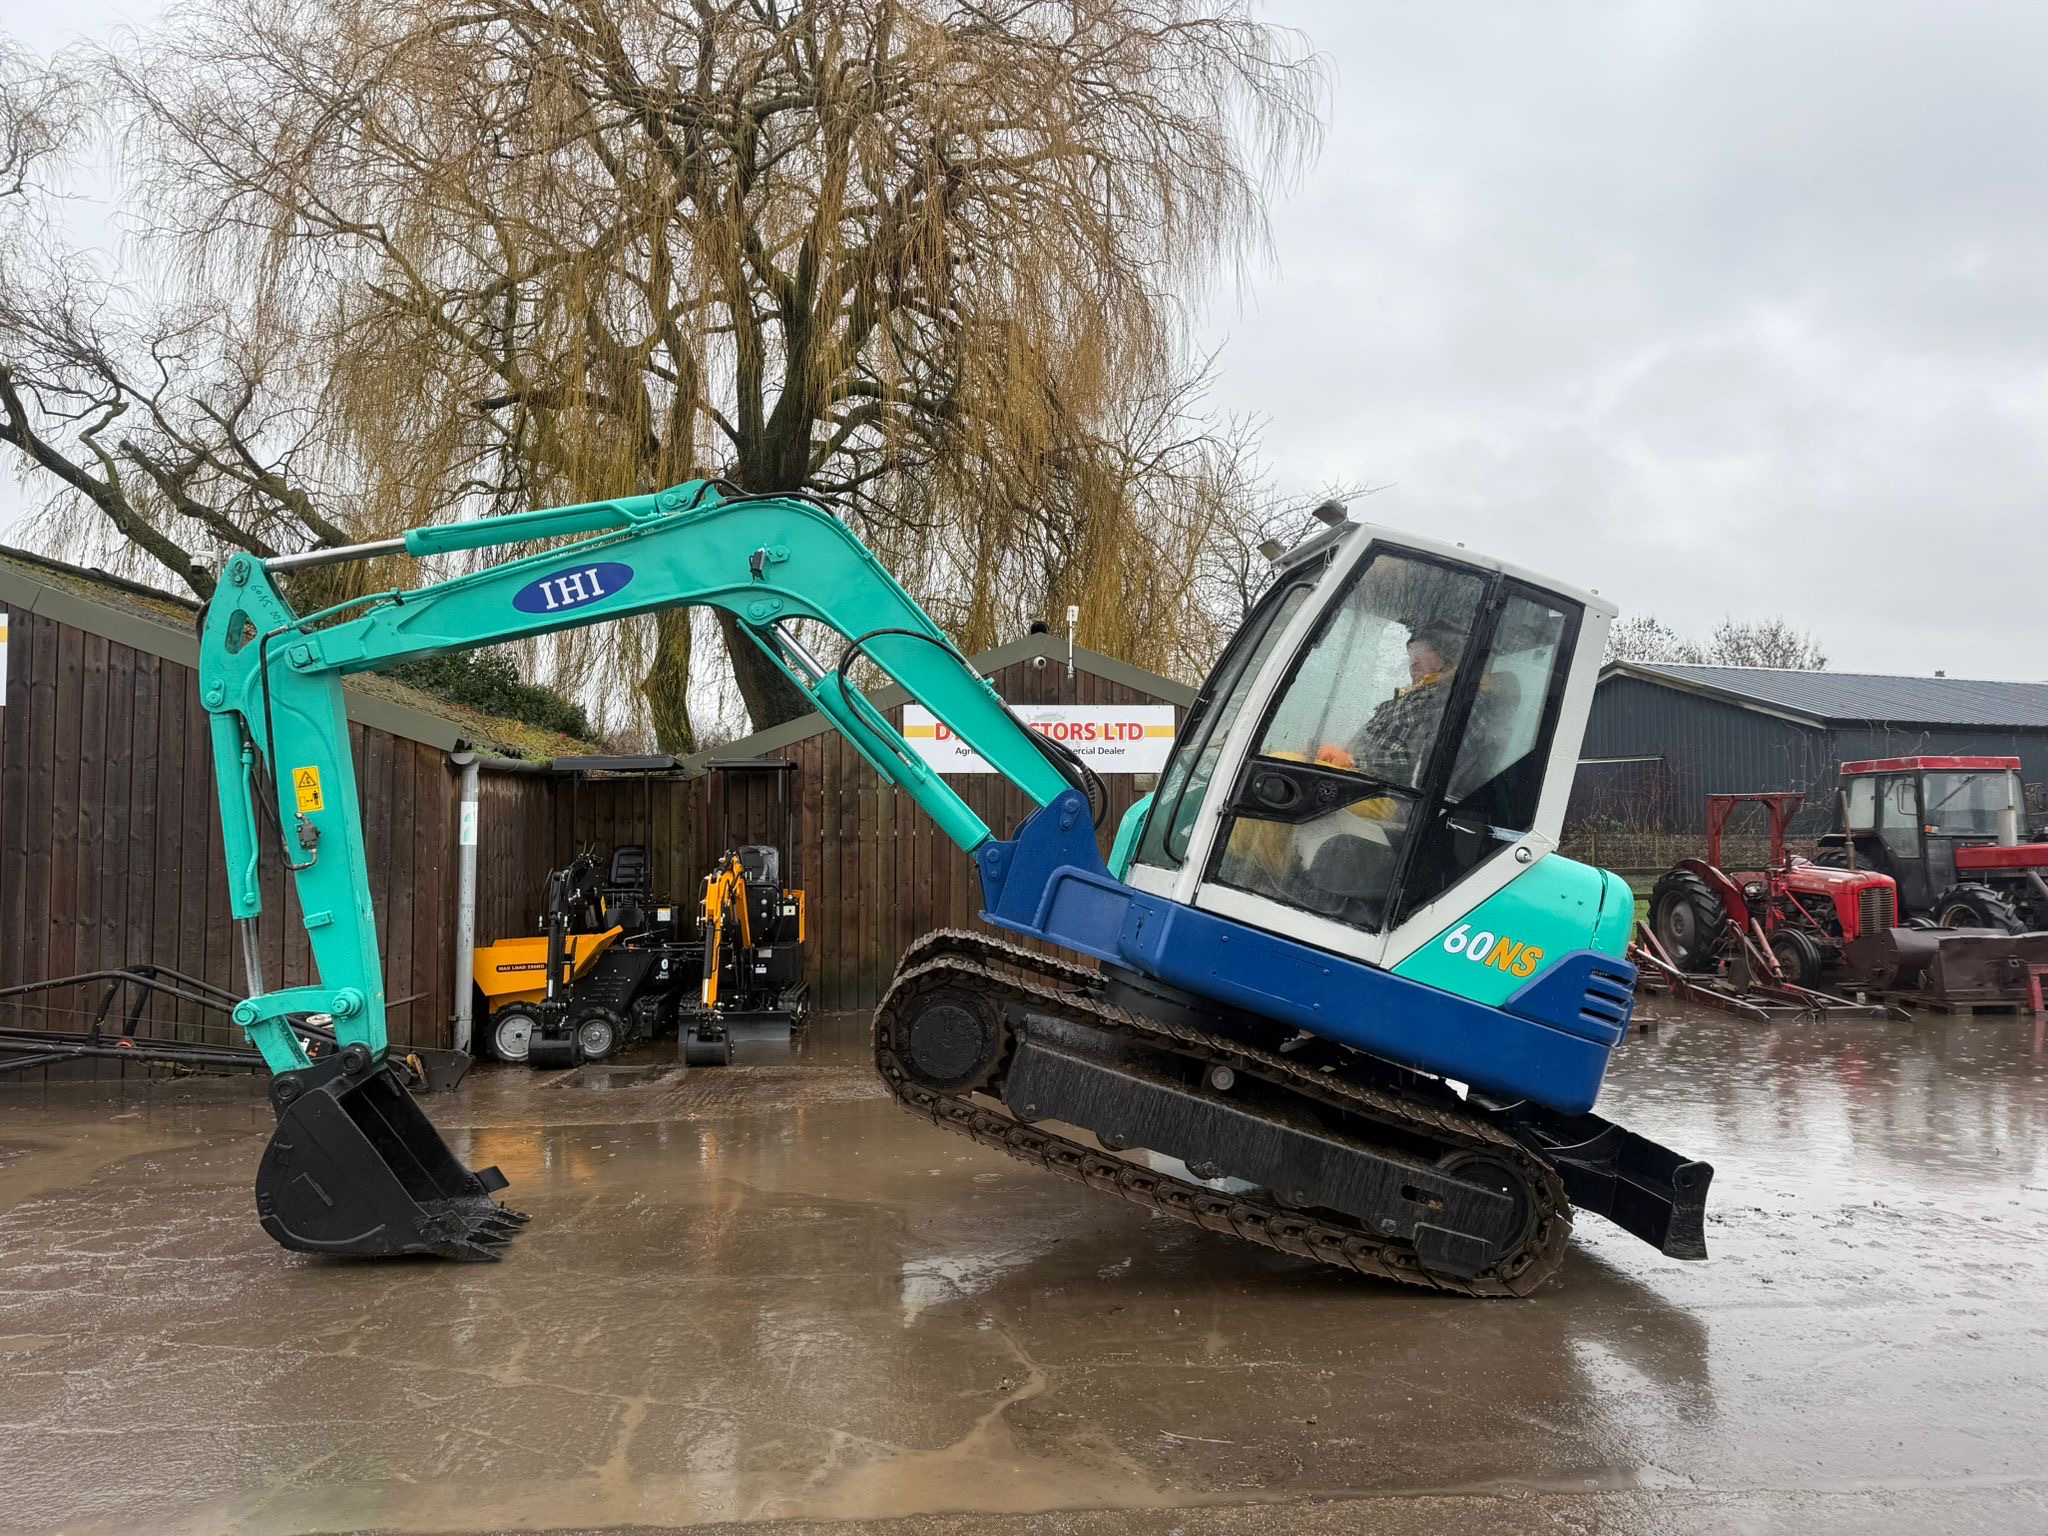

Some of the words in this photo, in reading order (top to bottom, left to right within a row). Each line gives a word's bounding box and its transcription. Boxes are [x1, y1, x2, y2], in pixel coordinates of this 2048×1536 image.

[539, 568, 605, 610] IHI
[935, 722, 961, 741] D
[1103, 722, 1144, 741] LTD
[1070, 746, 1096, 755] ercial
[1097, 746, 1126, 755] Dealer
[1443, 923, 1545, 978] 60NS
